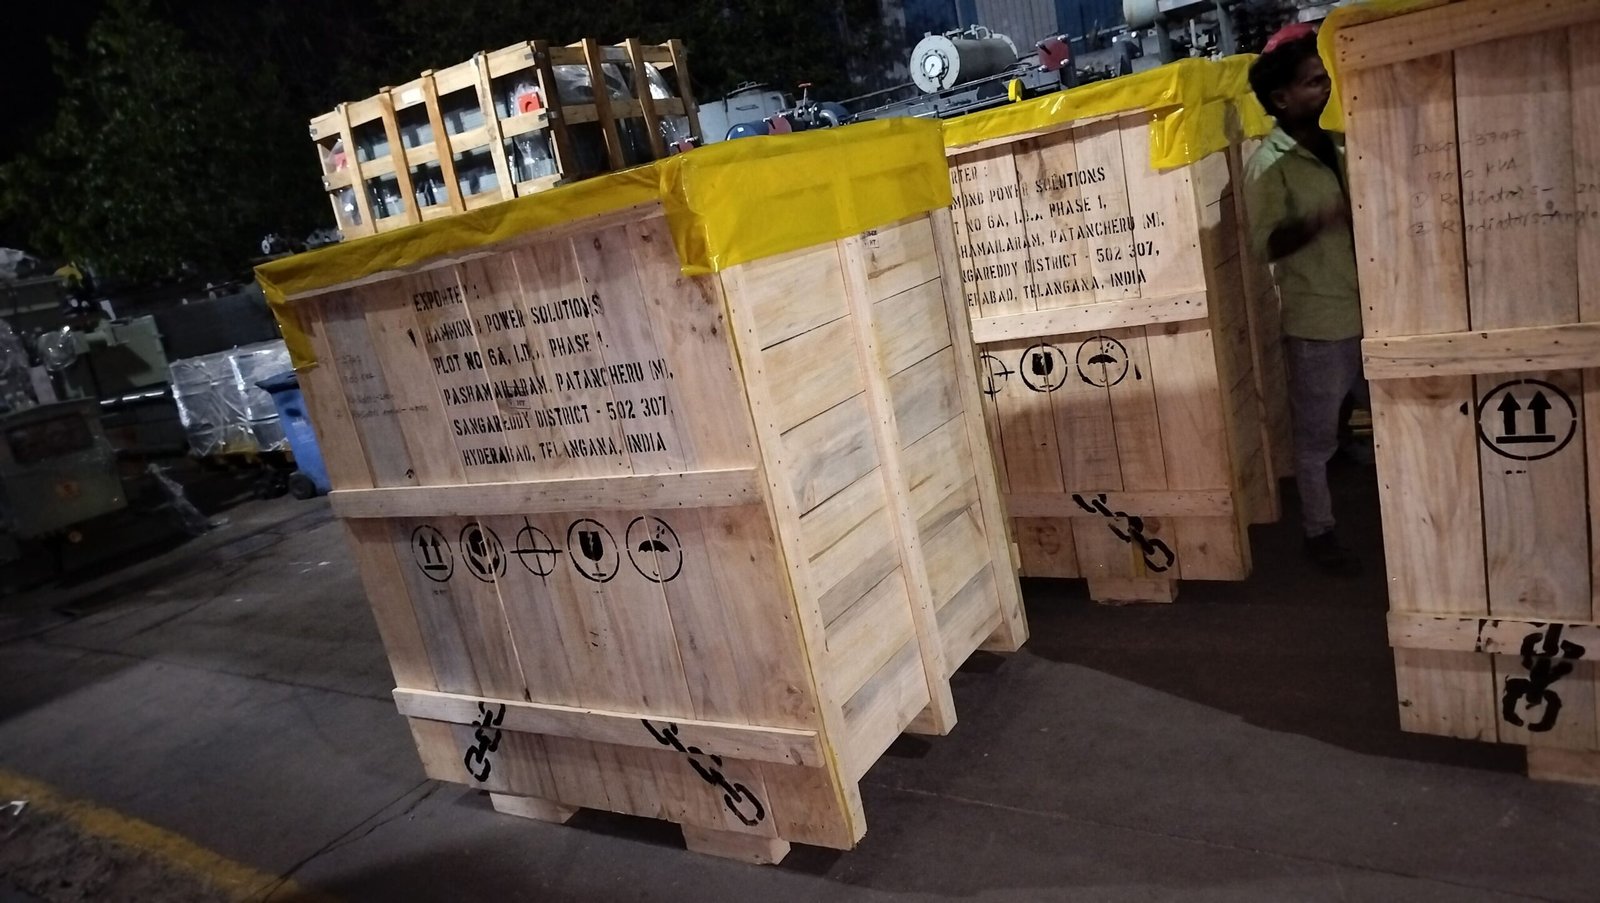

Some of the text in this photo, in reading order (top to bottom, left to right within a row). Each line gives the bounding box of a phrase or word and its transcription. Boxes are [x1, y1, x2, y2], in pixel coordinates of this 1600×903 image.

[989, 183, 1028, 203] POWER
[1035, 166, 1106, 193] SOLUTIONS
[966, 217, 982, 233] NO
[987, 213, 1010, 229] 6A,
[1049, 198, 1091, 218] PHASE
[1050, 216, 1135, 244] PATANCHERU
[1024, 253, 1077, 274] DISTRICT
[1096, 246, 1122, 263] 502
[1128, 241, 1160, 258] 307,
[1023, 276, 1105, 301] TELANGANA,
[1110, 268, 1147, 288] INDIA
[485, 309, 526, 334] POWER
[530, 294, 603, 325] SOLUTIONS
[433, 353, 462, 375] PLOT
[464, 350, 484, 371] NO
[487, 346, 511, 366] 6A,
[548, 333, 592, 358] PHASE
[555, 361, 645, 391] PATANCHERU
[453, 411, 531, 436] SANGAREDDY
[534, 404, 590, 428] DISTRICT
[606, 399, 636, 420] 502
[462, 431, 667, 467] HYDERABAD, TELANGANA, INDIA
